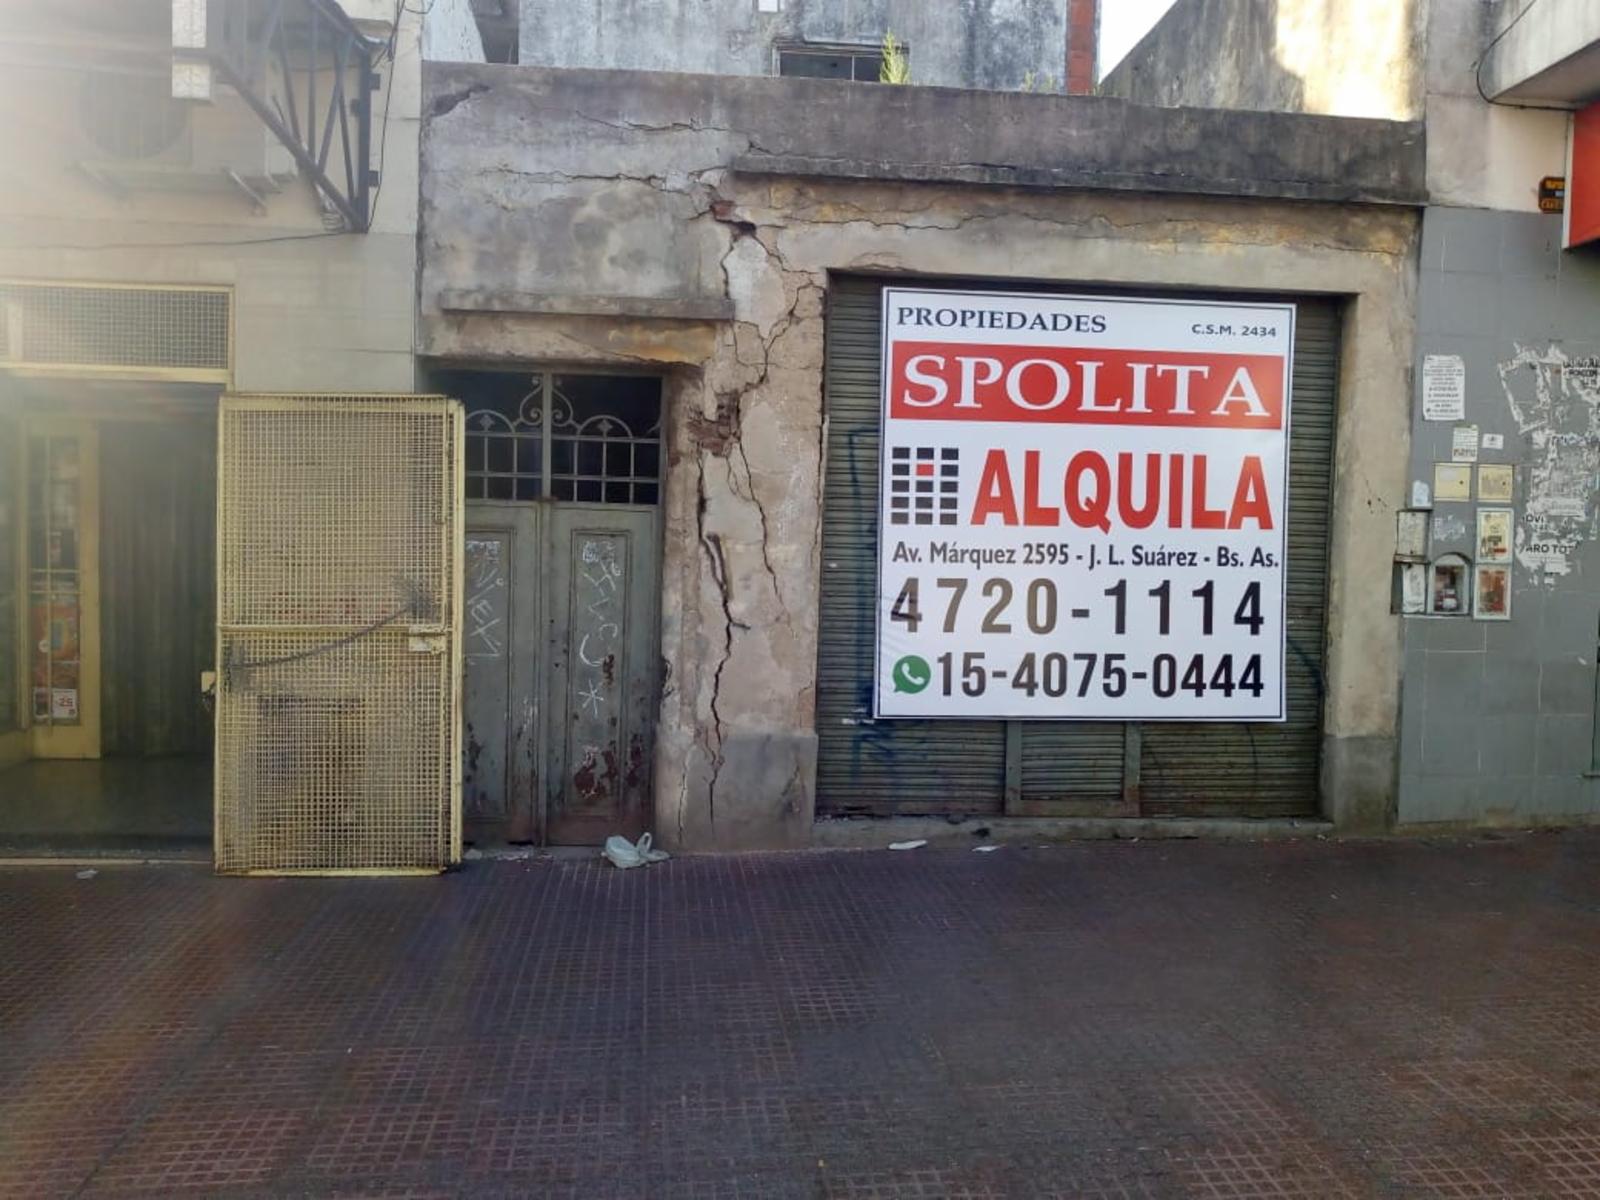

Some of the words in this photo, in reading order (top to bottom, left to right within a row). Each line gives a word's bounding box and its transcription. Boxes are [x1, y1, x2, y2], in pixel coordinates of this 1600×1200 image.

[898, 307, 1107, 333] PROPIEDADES
[1191, 323, 1236, 336] C.S.M.
[1241, 326, 1277, 338] 2434
[903, 354, 1272, 418] SPOLITA
[970, 448, 1274, 534] ALQUILA
[892, 541, 923, 563] Av.
[930, 541, 1016, 570] Márquez
[1023, 542, 1069, 565] 2595
[1088, 543, 1102, 571] J.
[1108, 544, 1125, 566] L.
[1131, 543, 1198, 567] Suárez
[1216, 546, 1244, 568] Bs.
[1249, 546, 1279, 568] As.
[890, 577, 1265, 637] 4720-1114
[937, 652, 1265, 699] 15-4075-0444
